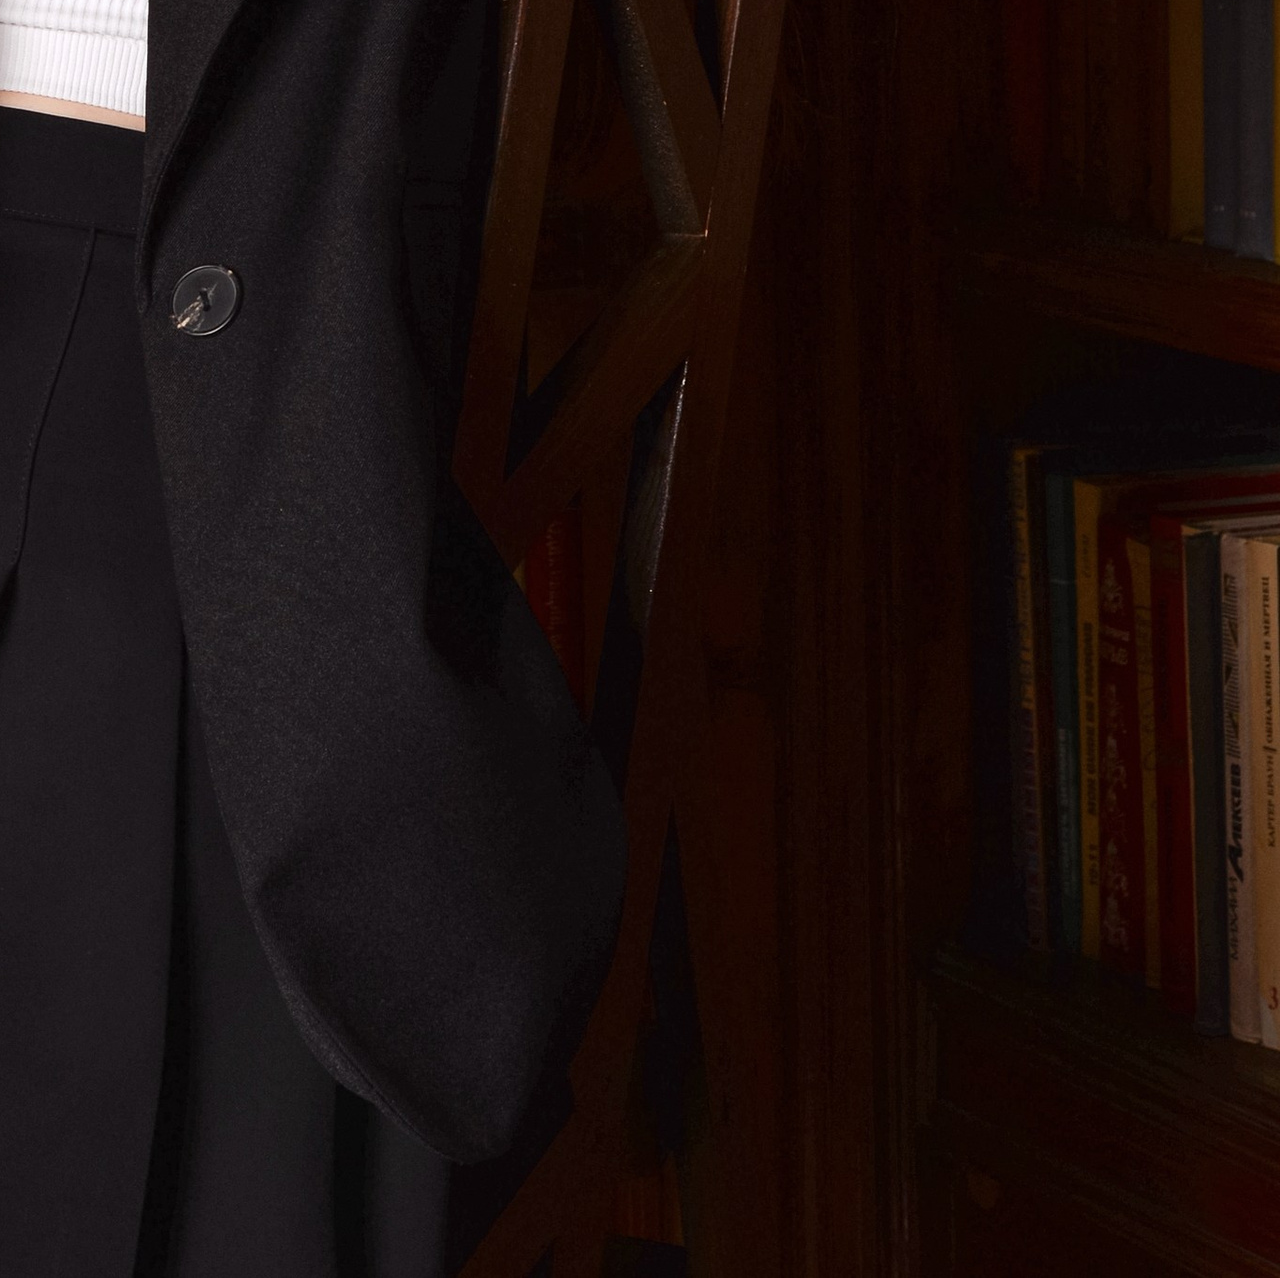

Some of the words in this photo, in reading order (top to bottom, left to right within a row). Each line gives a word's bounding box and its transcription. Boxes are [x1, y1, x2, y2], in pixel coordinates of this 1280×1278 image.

[1263, 654, 1275, 744] ОБНАЖЕННАЯ
[1266, 754, 1276, 797] БРАУН
[1227, 762, 1244, 883] АЛЕКСЕЕВ
[1266, 798, 1277, 848] КАРТЕР
